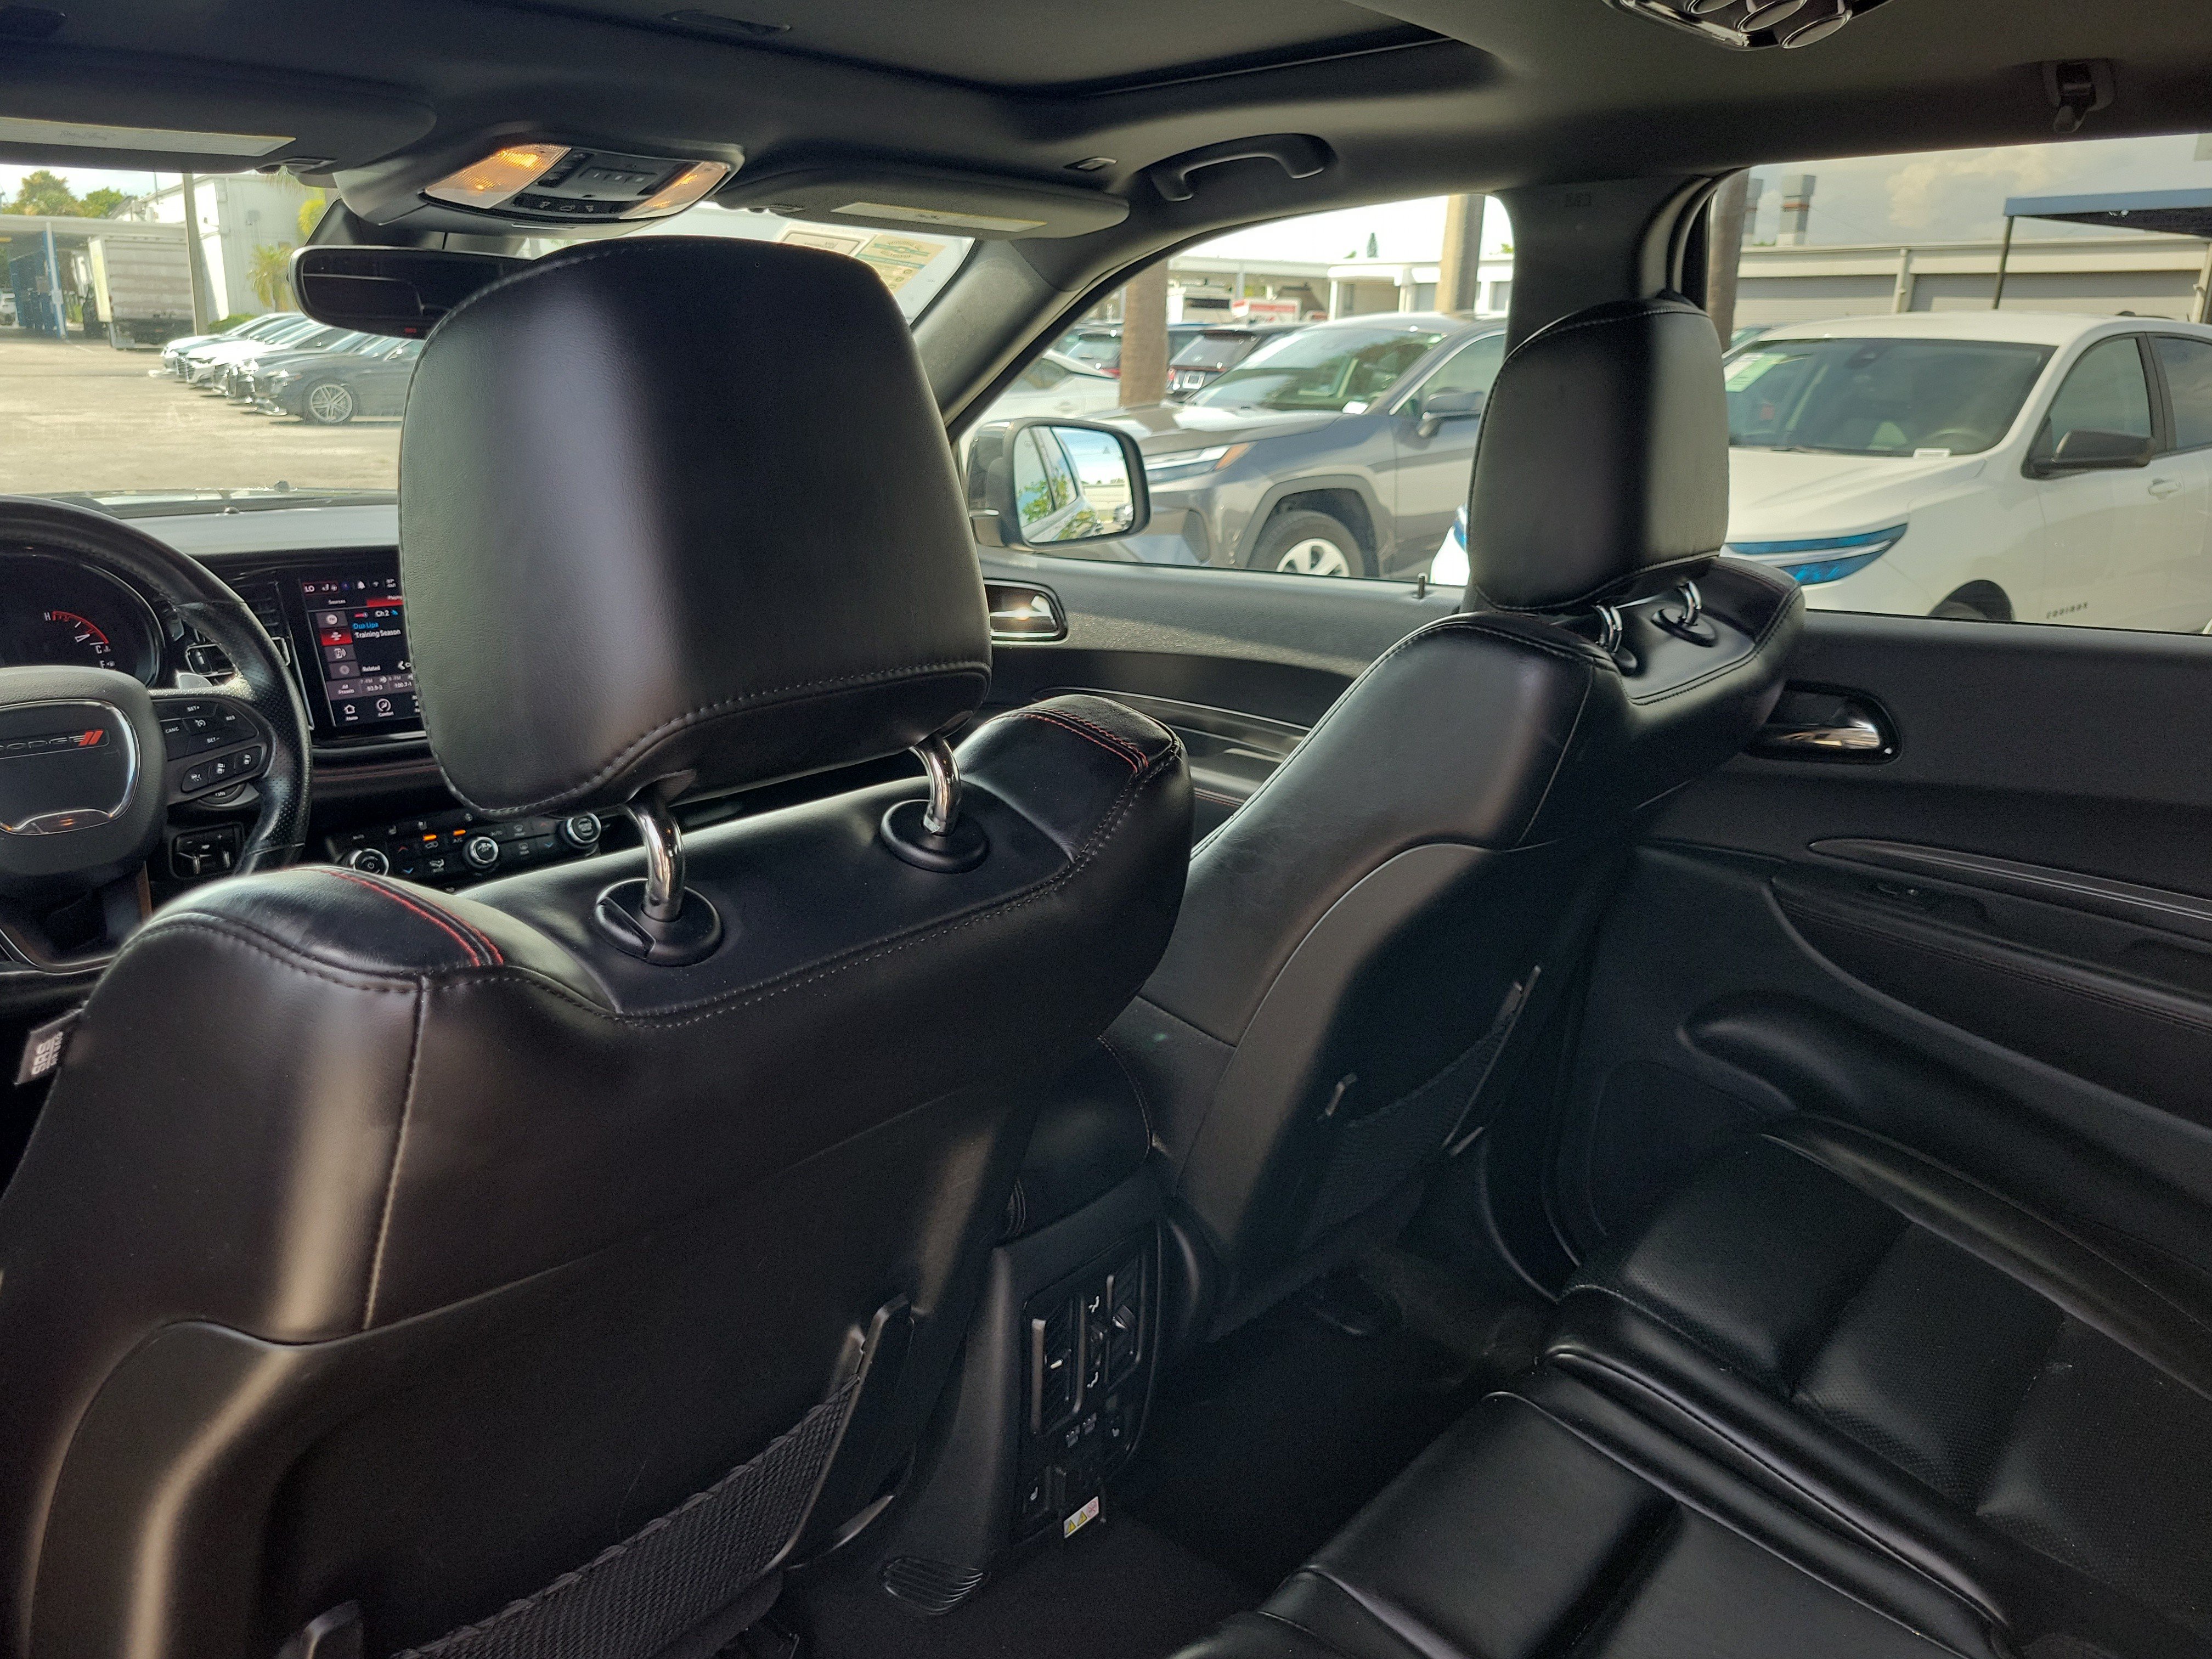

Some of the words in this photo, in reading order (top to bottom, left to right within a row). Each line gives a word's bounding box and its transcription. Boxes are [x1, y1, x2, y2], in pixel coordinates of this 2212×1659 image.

[44, 612, 51, 621] H
[356, 629, 380, 639] Training
[380, 628, 402, 637] Season
[95, 645, 103, 654] C
[100, 660, 105, 669] F
[0, 734, 86, 750] ODGE
